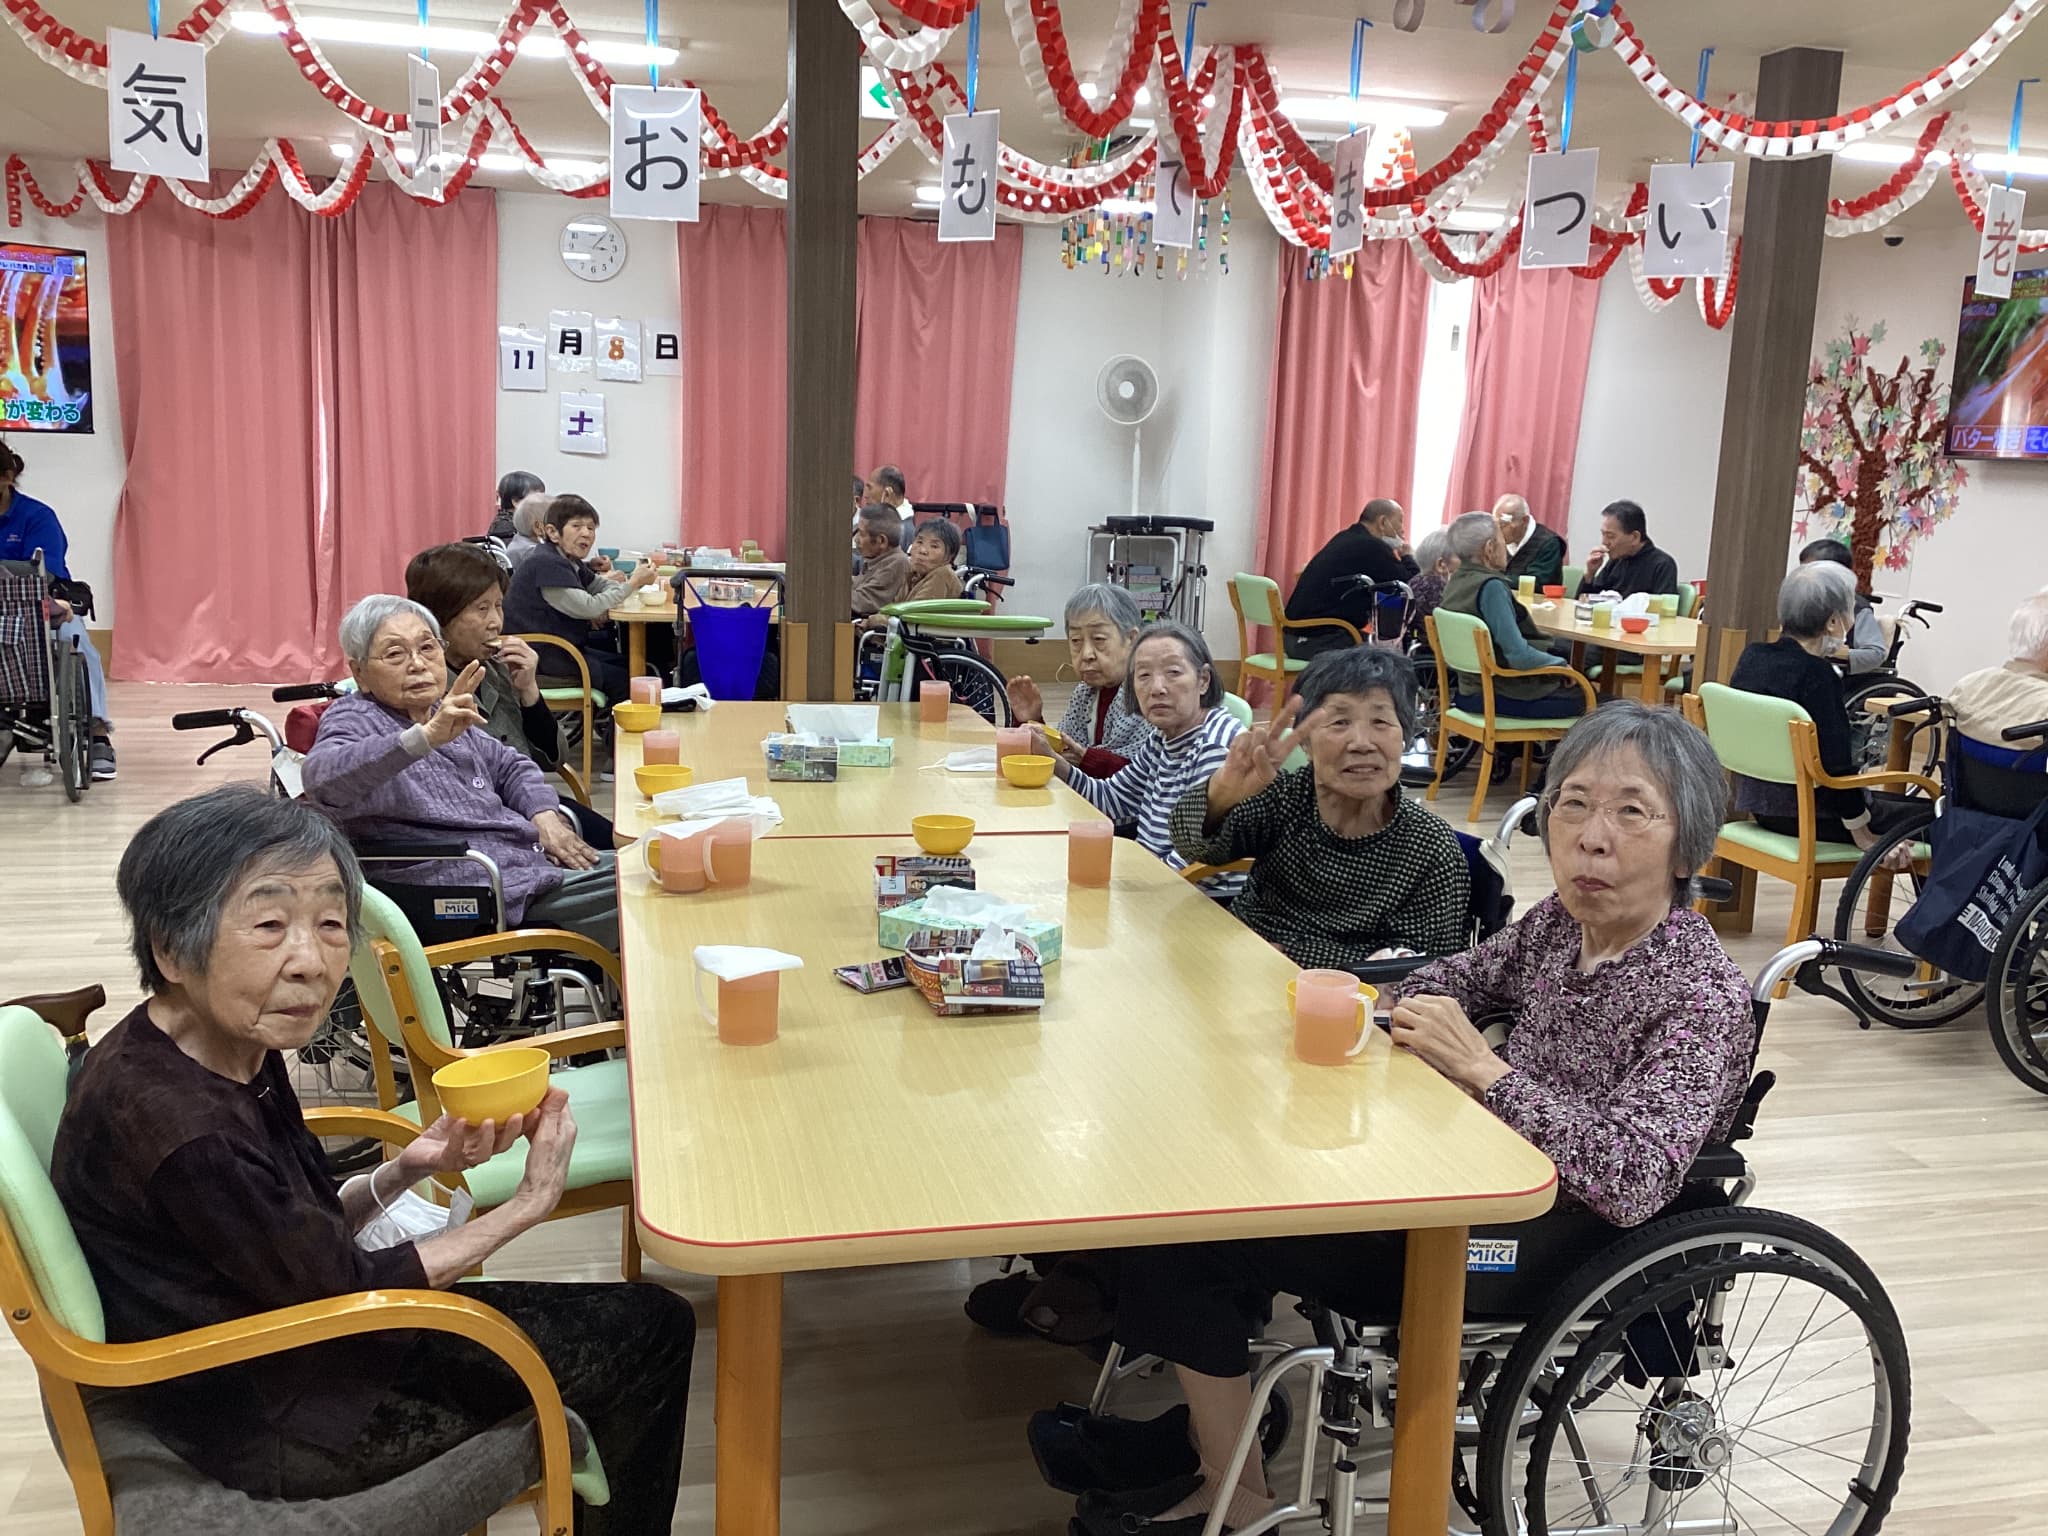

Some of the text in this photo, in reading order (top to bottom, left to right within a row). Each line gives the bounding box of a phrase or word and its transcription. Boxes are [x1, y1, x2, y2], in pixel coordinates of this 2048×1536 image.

[122, 62, 203, 157] 気
[624, 119, 689, 192] お
[950, 143, 987, 216] も
[1336, 160, 1357, 229] ま
[1533, 191, 1586, 236] つ
[1658, 202, 1717, 250] い
[609, 233, 615, 242] 2
[612, 244, 618, 253] 3
[1983, 210, 2017, 277] 老
[580, 261, 586, 270] 7
[590, 265, 597, 274] 6
[602, 263, 607, 272] 5
[513, 328, 679, 370] 11 月 8 日
[0, 398, 81, 423] が変わる
[567, 410, 594, 436] 土
